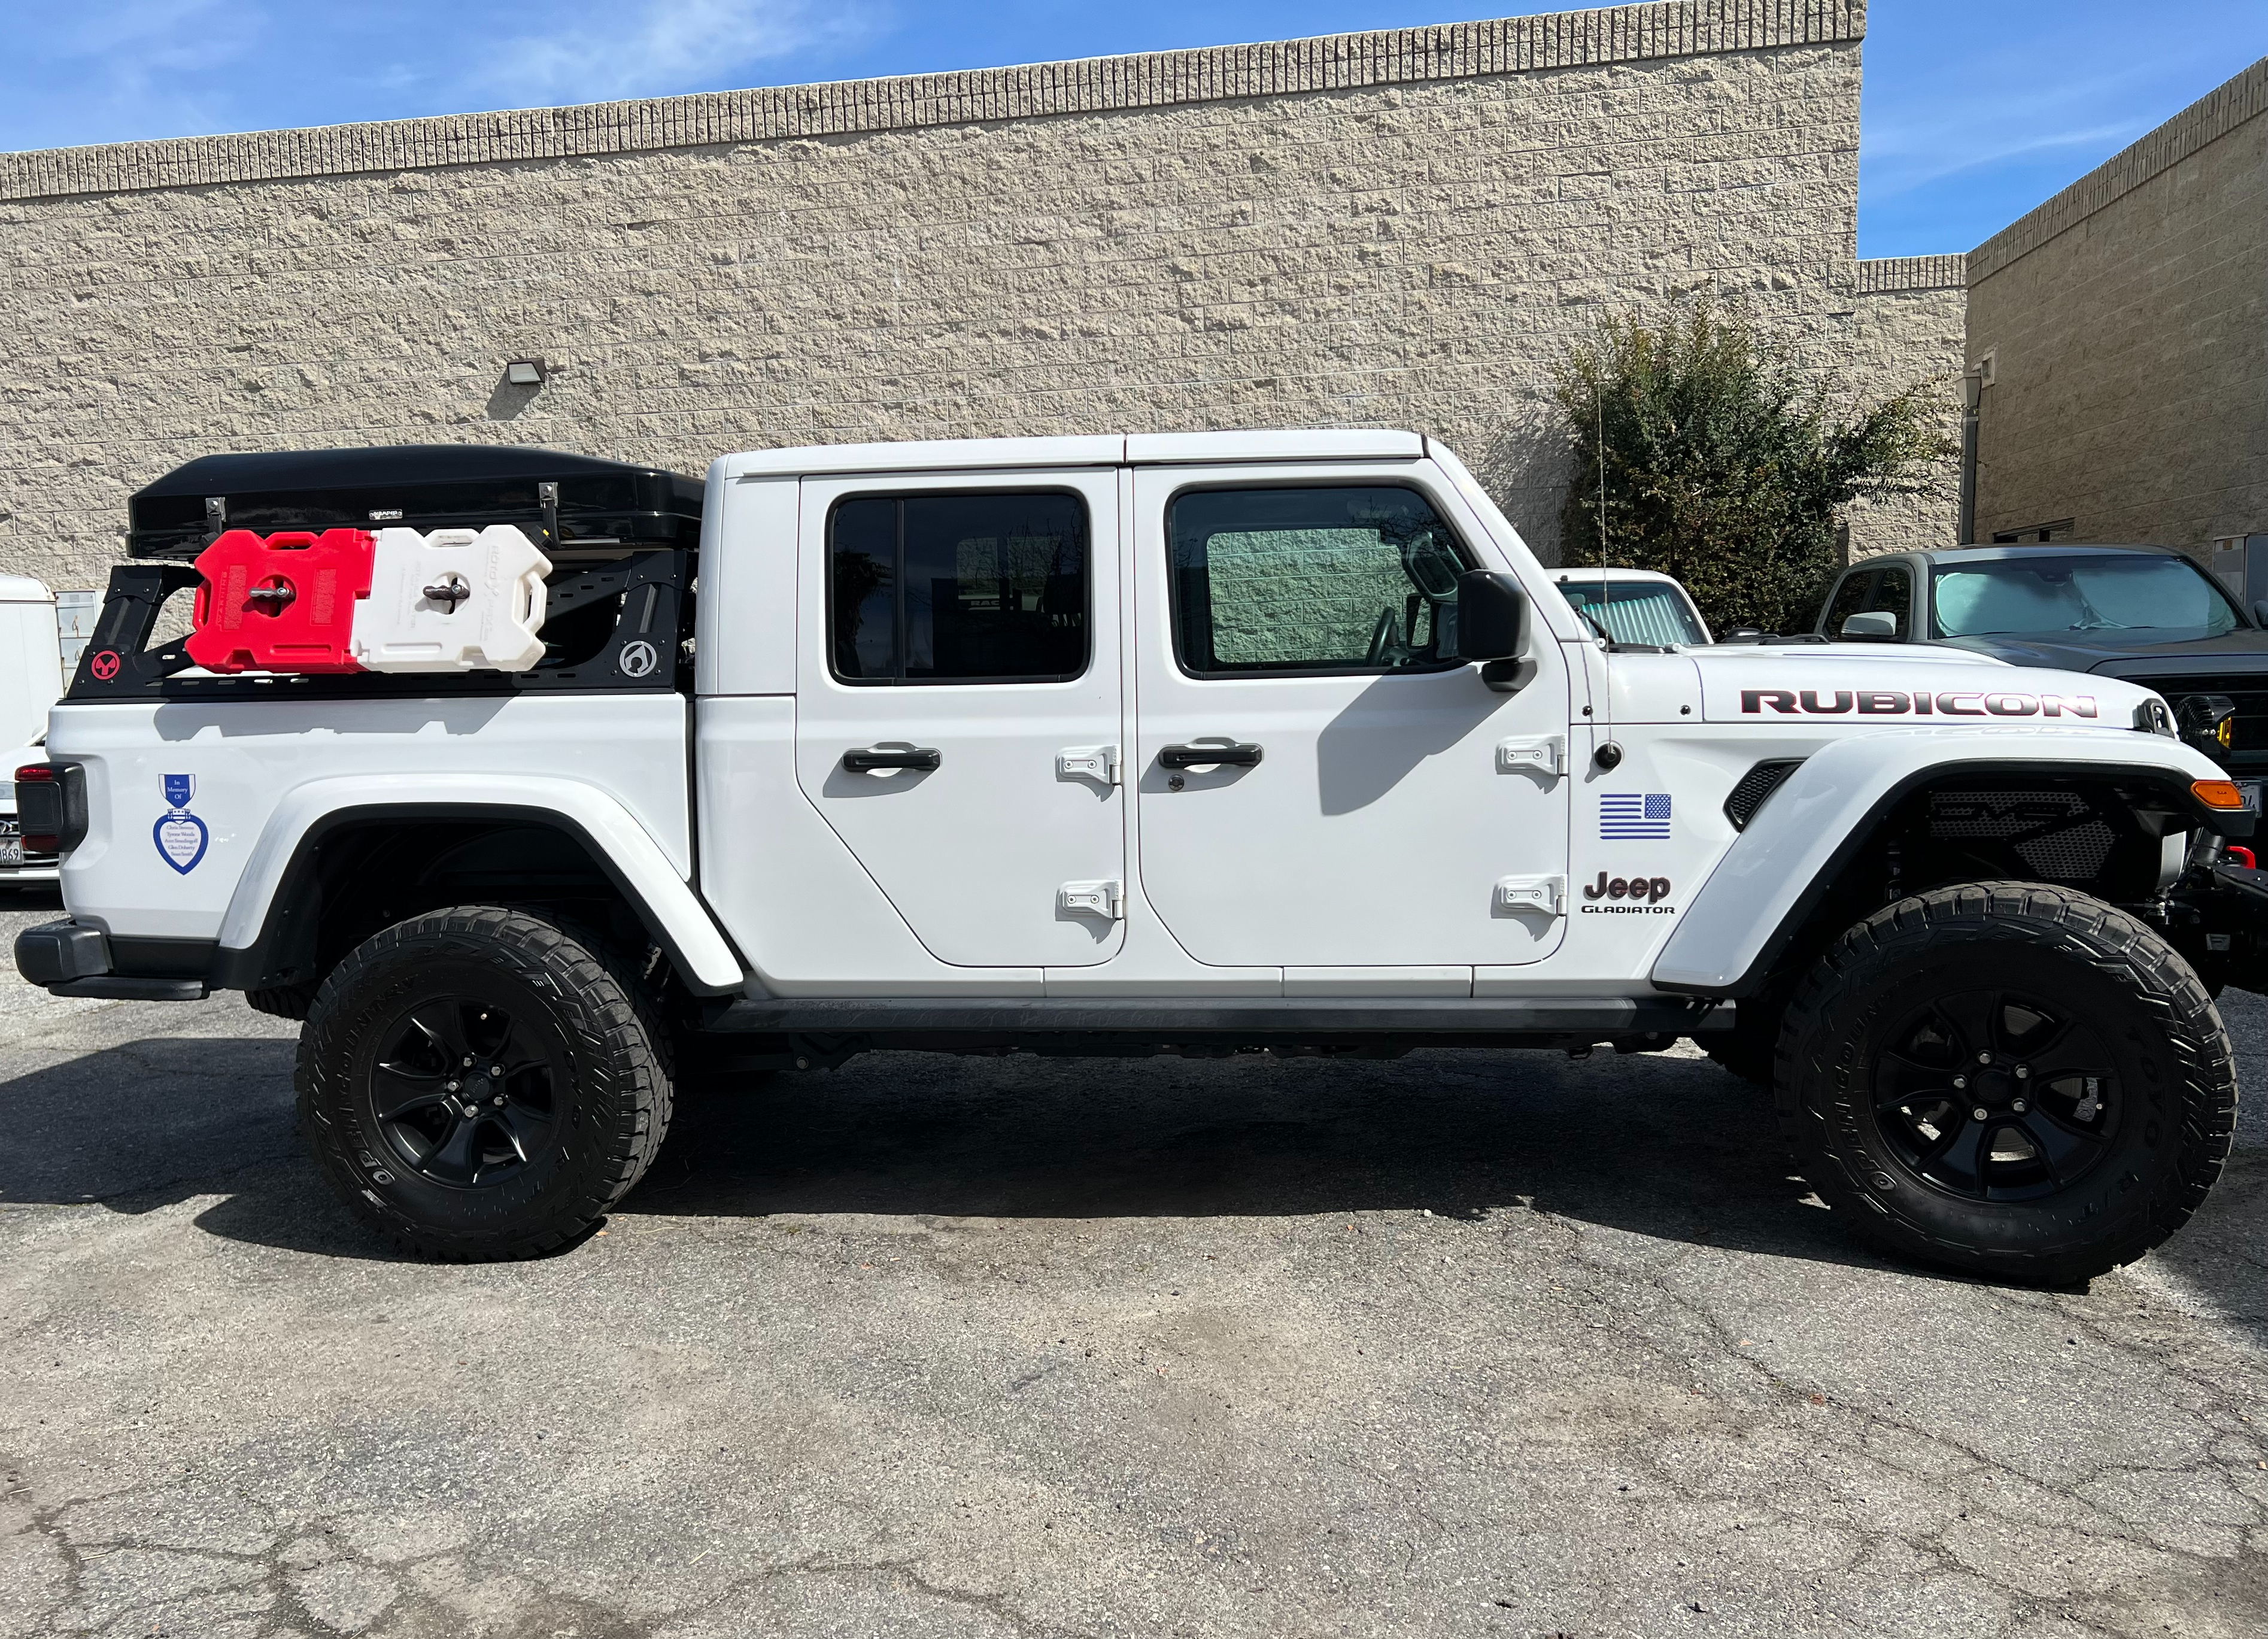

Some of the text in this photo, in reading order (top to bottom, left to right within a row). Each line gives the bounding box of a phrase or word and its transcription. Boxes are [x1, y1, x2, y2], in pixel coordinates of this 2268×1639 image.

[217, 572, 227, 623] WARNING
[1741, 690, 2098, 718] RUBICON
[0, 848, 19, 860] 869
[1585, 872, 1670, 902] Jeep
[1581, 905, 1675, 914] GLADIATOR
[338, 1106, 396, 1186] OPEN
[1835, 1100, 1897, 1191] OPEN
